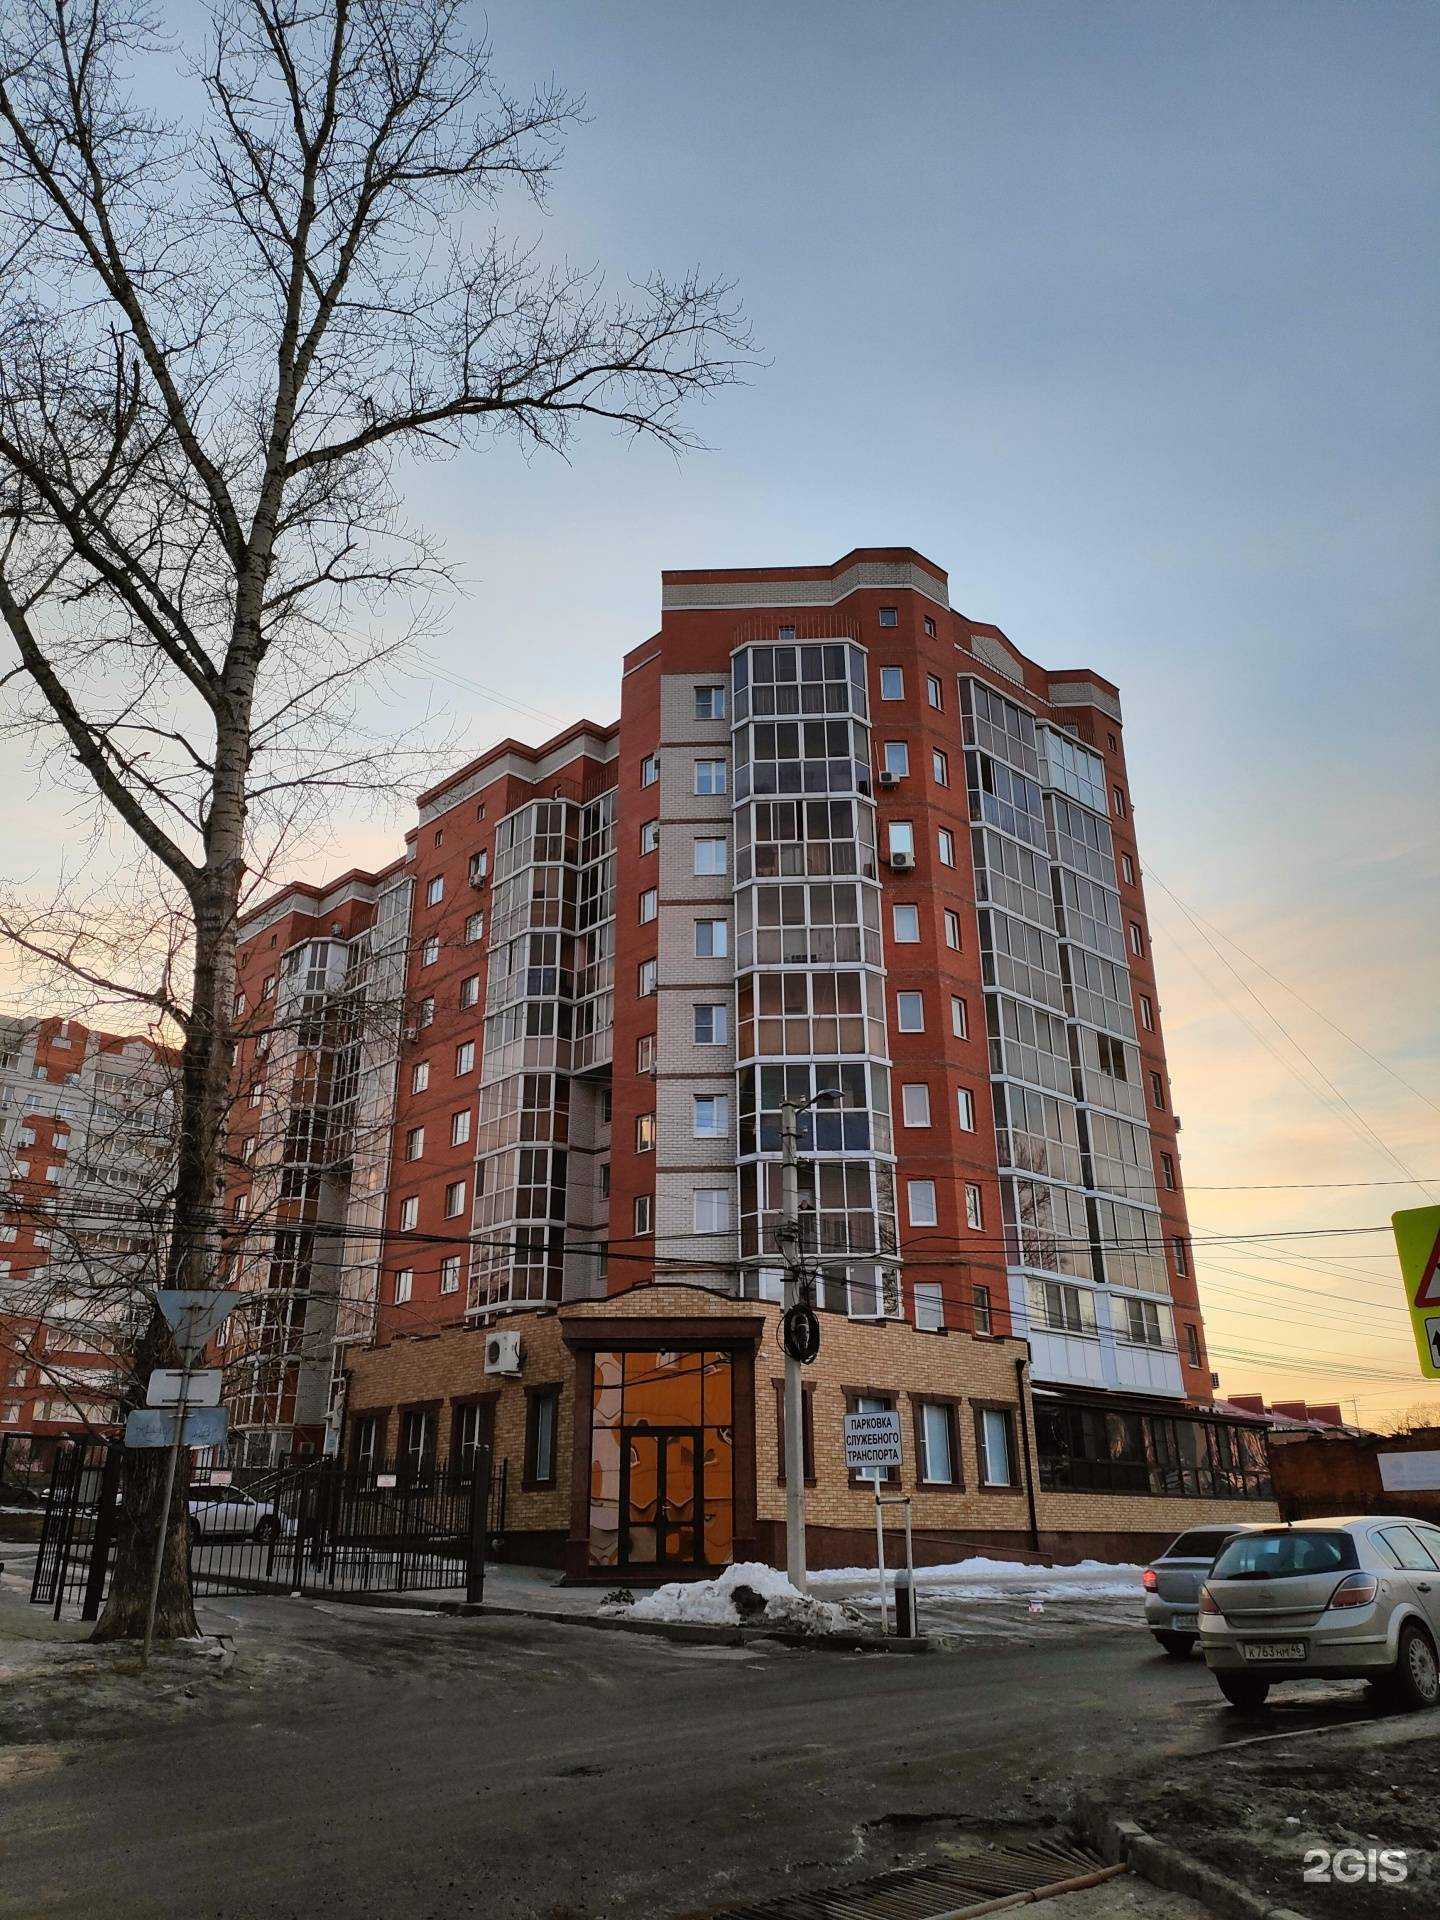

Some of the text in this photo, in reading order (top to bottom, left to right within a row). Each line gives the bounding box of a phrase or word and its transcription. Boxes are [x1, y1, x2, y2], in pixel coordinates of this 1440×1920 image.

[851, 1417, 893, 1430] ПАРКОВКА
[846, 1432, 899, 1446] СЛУЖЕБНОГО
[848, 1448, 899, 1461] ТРАНСПОРТА
